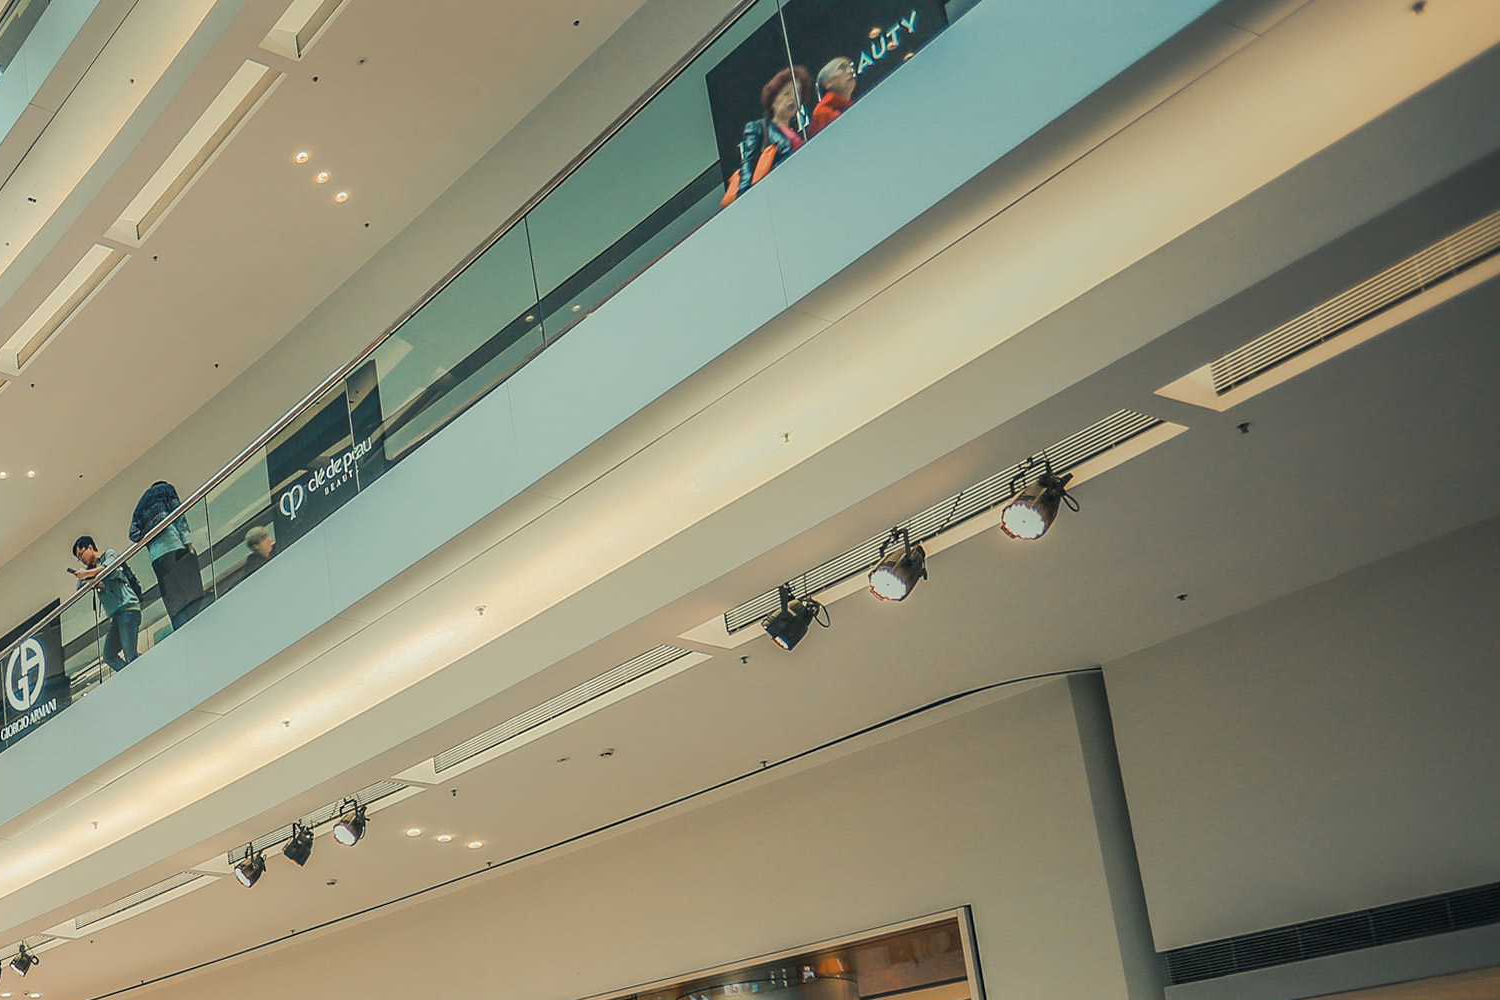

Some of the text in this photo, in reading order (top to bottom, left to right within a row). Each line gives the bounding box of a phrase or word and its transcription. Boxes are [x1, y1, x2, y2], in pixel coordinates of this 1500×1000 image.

[324, 466, 358, 495] BEAUT
[0, 698, 57, 740] GIORGIO ARMANI
